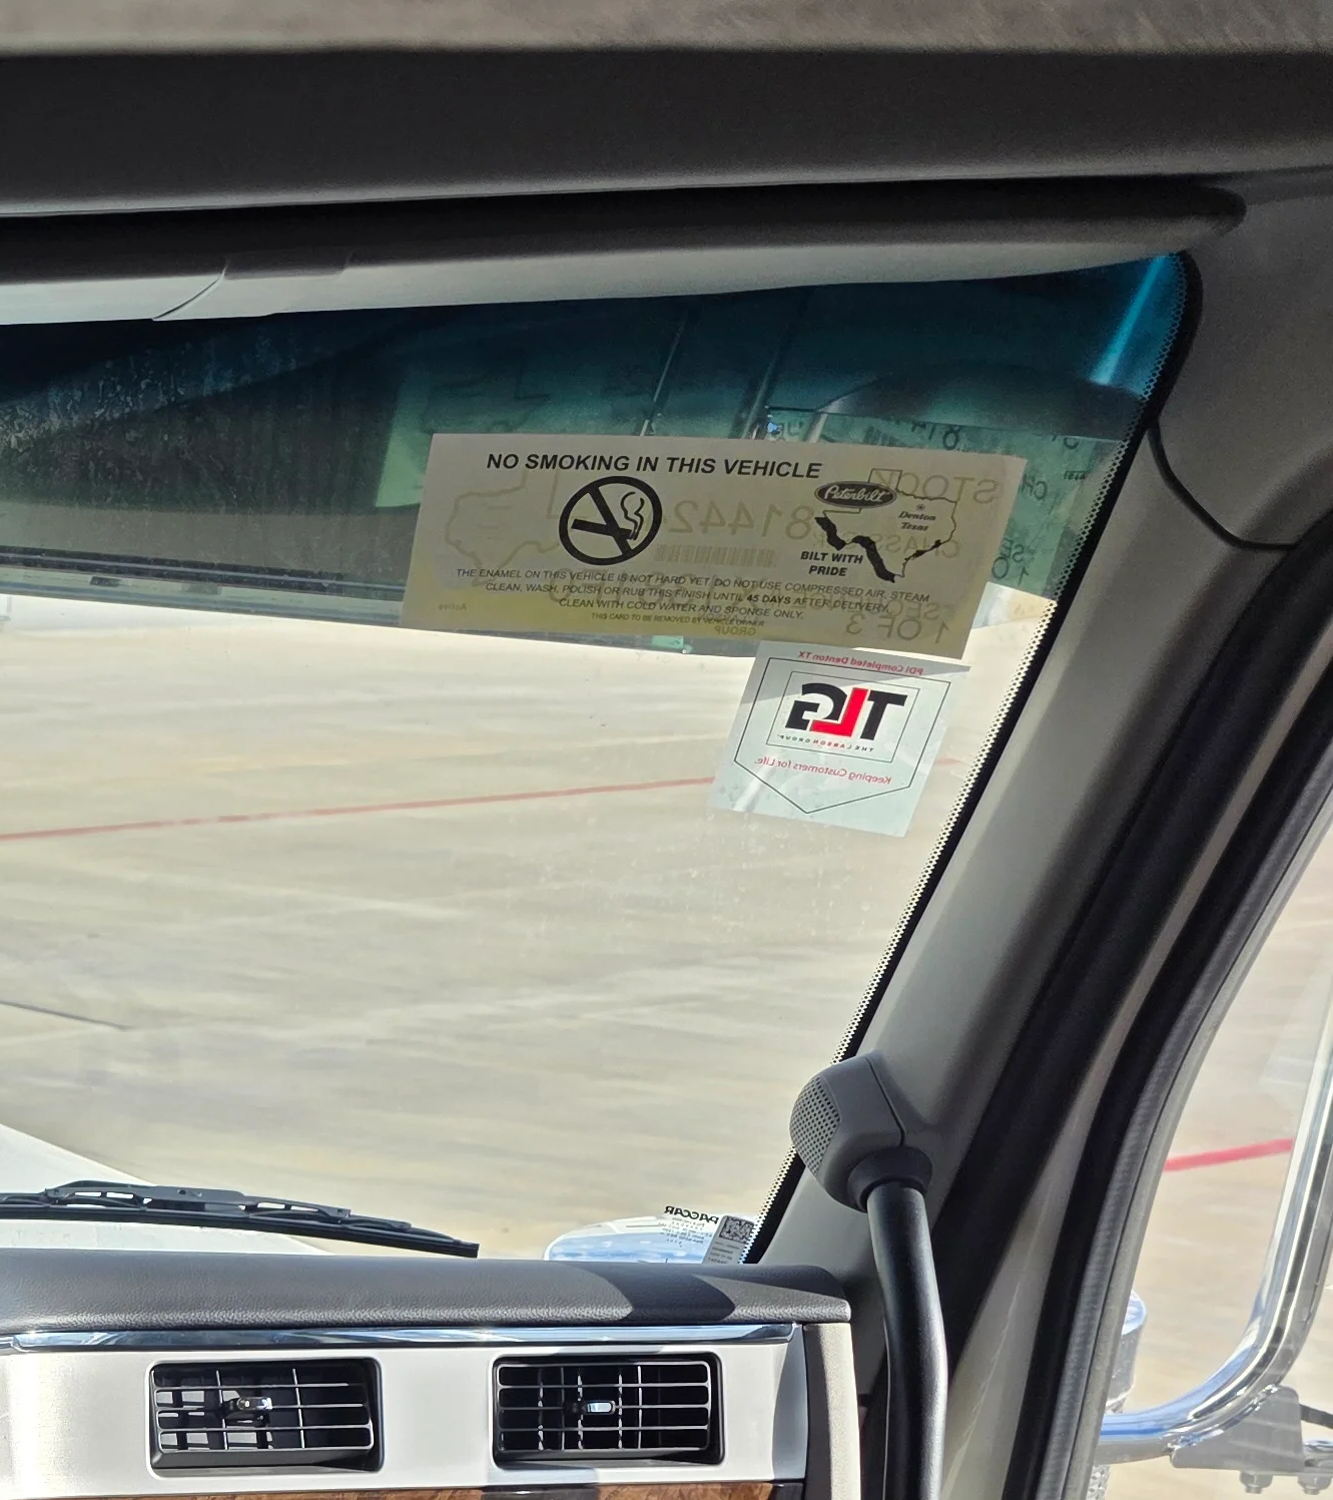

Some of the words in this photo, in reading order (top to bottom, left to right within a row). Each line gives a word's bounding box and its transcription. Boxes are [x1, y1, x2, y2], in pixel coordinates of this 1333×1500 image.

[487, 453, 519, 470] NO
[525, 454, 630, 472] SMOKING
[636, 456, 660, 472] IN
[666, 457, 717, 474] THIS
[724, 459, 823, 479] VEHICLE
[823, 484, 891, 504] Peterbilt
[898, 511, 936, 521] Denton
[901, 522, 929, 532] Texas
[800, 551, 828, 562] BILT
[832, 553, 864, 564] WITH
[809, 565, 848, 577] PRIDE
[456, 568, 475, 578] THE
[478, 569, 522, 579] ENAMEL
[524, 570, 541, 579] ON
[543, 570, 567, 580] THIS
[569, 571, 614, 582] VEHICLE
[617, 573, 628, 582] IS
[629, 574, 654, 583] NOT
[657, 575, 686, 585] HARD
[713, 578, 732, 587] DO
[733, 579, 756, 589] NOT
[758, 580, 782, 590] USE
[785, 582, 864, 597] COMPRESSED
[890, 590, 931, 602] STEAM
[562, 584, 601, 595] POLISH
[603, 586, 619, 595] OR
[622, 586, 645, 597] RUB
[648, 588, 673, 598] THIS
[674, 589, 711, 600] FINISH
[713, 591, 744, 602] UNTIL
[746, 594, 758, 603] 45
[761, 595, 792, 605] DAYS
[793, 597, 833, 607] AFTER
[558, 598, 594, 608] CLEAN
[596, 599, 624, 609] WITH
[626, 600, 656, 610] COLD
[658, 602, 696, 612] WATER
[699, 604, 722, 614] AND
[724, 605, 770, 617] SPONGE
